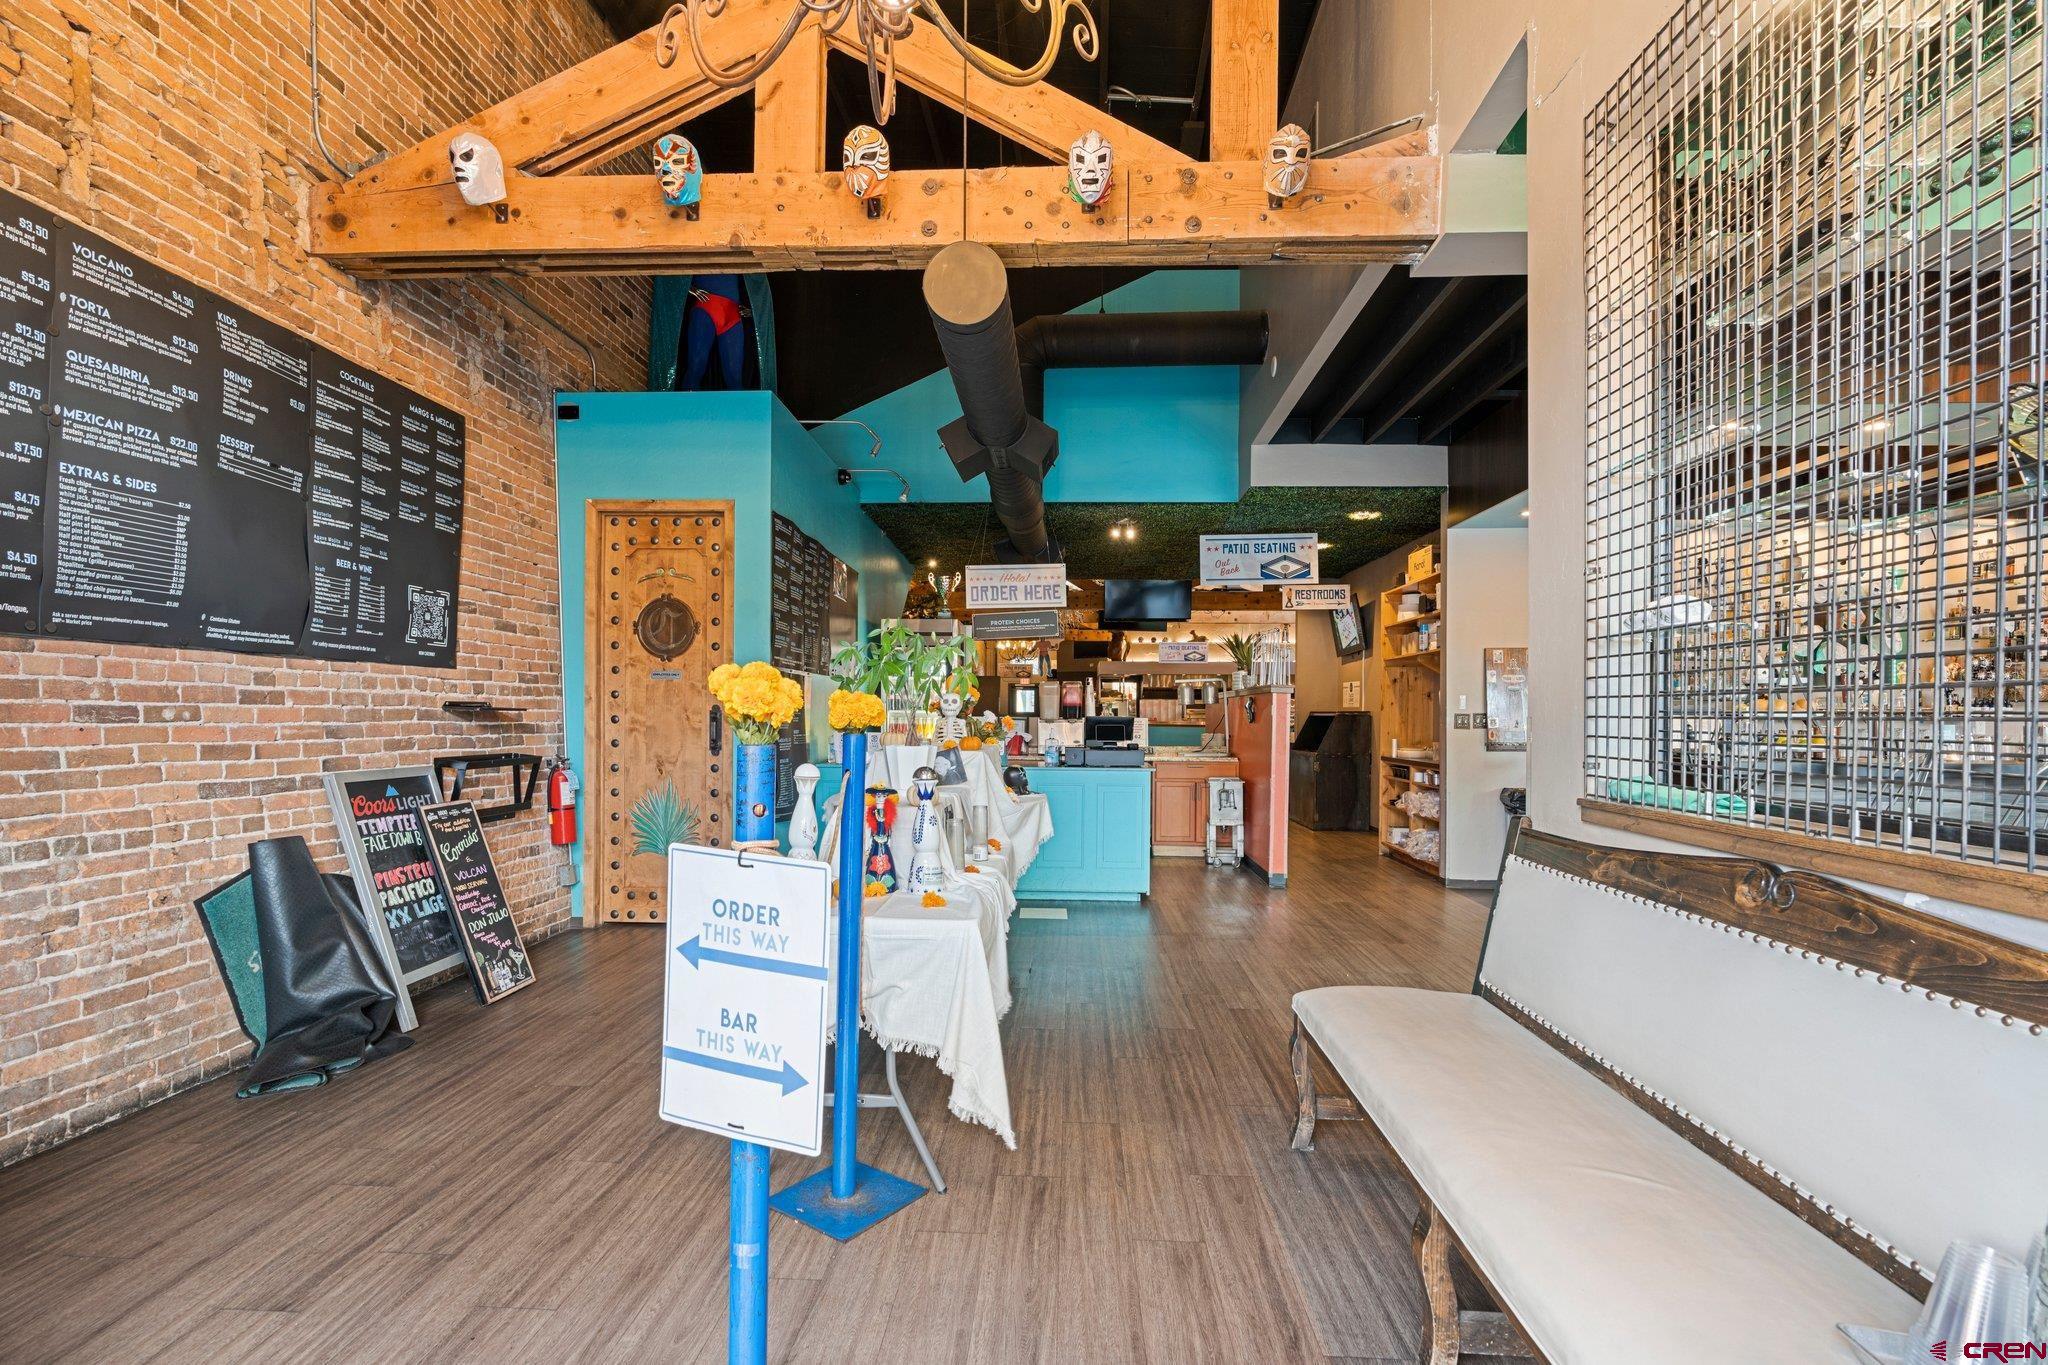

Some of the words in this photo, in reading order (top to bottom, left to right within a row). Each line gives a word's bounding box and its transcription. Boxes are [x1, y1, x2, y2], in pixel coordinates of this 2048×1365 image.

[19, 216, 48, 240] $3.50
[72, 241, 132, 278] VOLCANO
[21, 270, 49, 291] $5.25
[69, 294, 110, 319] TORTA
[217, 311, 237, 328] KIDS
[15, 323, 45, 343] $12.50
[172, 334, 198, 353] $12.50
[66, 348, 149, 385] QUESABIRRIA
[223, 367, 252, 388] DRINKS
[339, 369, 374, 392] COCKTAILS
[9, 380, 40, 400] $13.75
[172, 384, 198, 402] $13.50
[289, 397, 305, 412] $3.00
[63, 406, 122, 432] MEXICAN
[126, 423, 160, 442] PIZZA
[409, 403, 429, 419] MARGS
[435, 415, 455, 431] MEZCAL
[14, 441, 42, 458] $7.50
[169, 435, 197, 452] $22.00
[219, 433, 254, 454] DESSERT
[59, 461, 109, 482] EXTRAS
[112, 473, 121, 485] &
[125, 476, 156, 493] SIDES
[14, 490, 39, 505] $4.75
[7, 550, 36, 564] $4.50
[1222, 543, 1250, 554] PATIO
[1254, 542, 1296, 554] SEATING
[336, 558, 350, 568] BEER
[352, 562, 357, 570] &
[358, 563, 372, 573] WINE
[1214, 558, 1230, 568] Out
[1220, 564, 1240, 576] Back
[970, 585, 1018, 602] ORDER
[1024, 584, 1061, 600] HERE
[1295, 589, 1346, 600] RESTROOMS
[351, 795, 396, 816] Coors
[396, 794, 430, 810] LIGHT
[361, 833, 390, 853] FACE
[390, 832, 414, 848] DOWN
[440, 829, 479, 862] Corrido
[454, 864, 488, 880] VOLCAN
[378, 878, 435, 908] PACIFICO
[468, 878, 488, 890] SERVING
[385, 906, 412, 929] XX
[468, 916, 488, 934] DON
[487, 908, 508, 924] JULIO
[712, 898, 780, 926] ORDER
[703, 922, 741, 946] THIS
[750, 930, 790, 954] WAY
[720, 1008, 757, 1034] BAR
[696, 1028, 734, 1053] THIS
[744, 1038, 782, 1062] WAY
